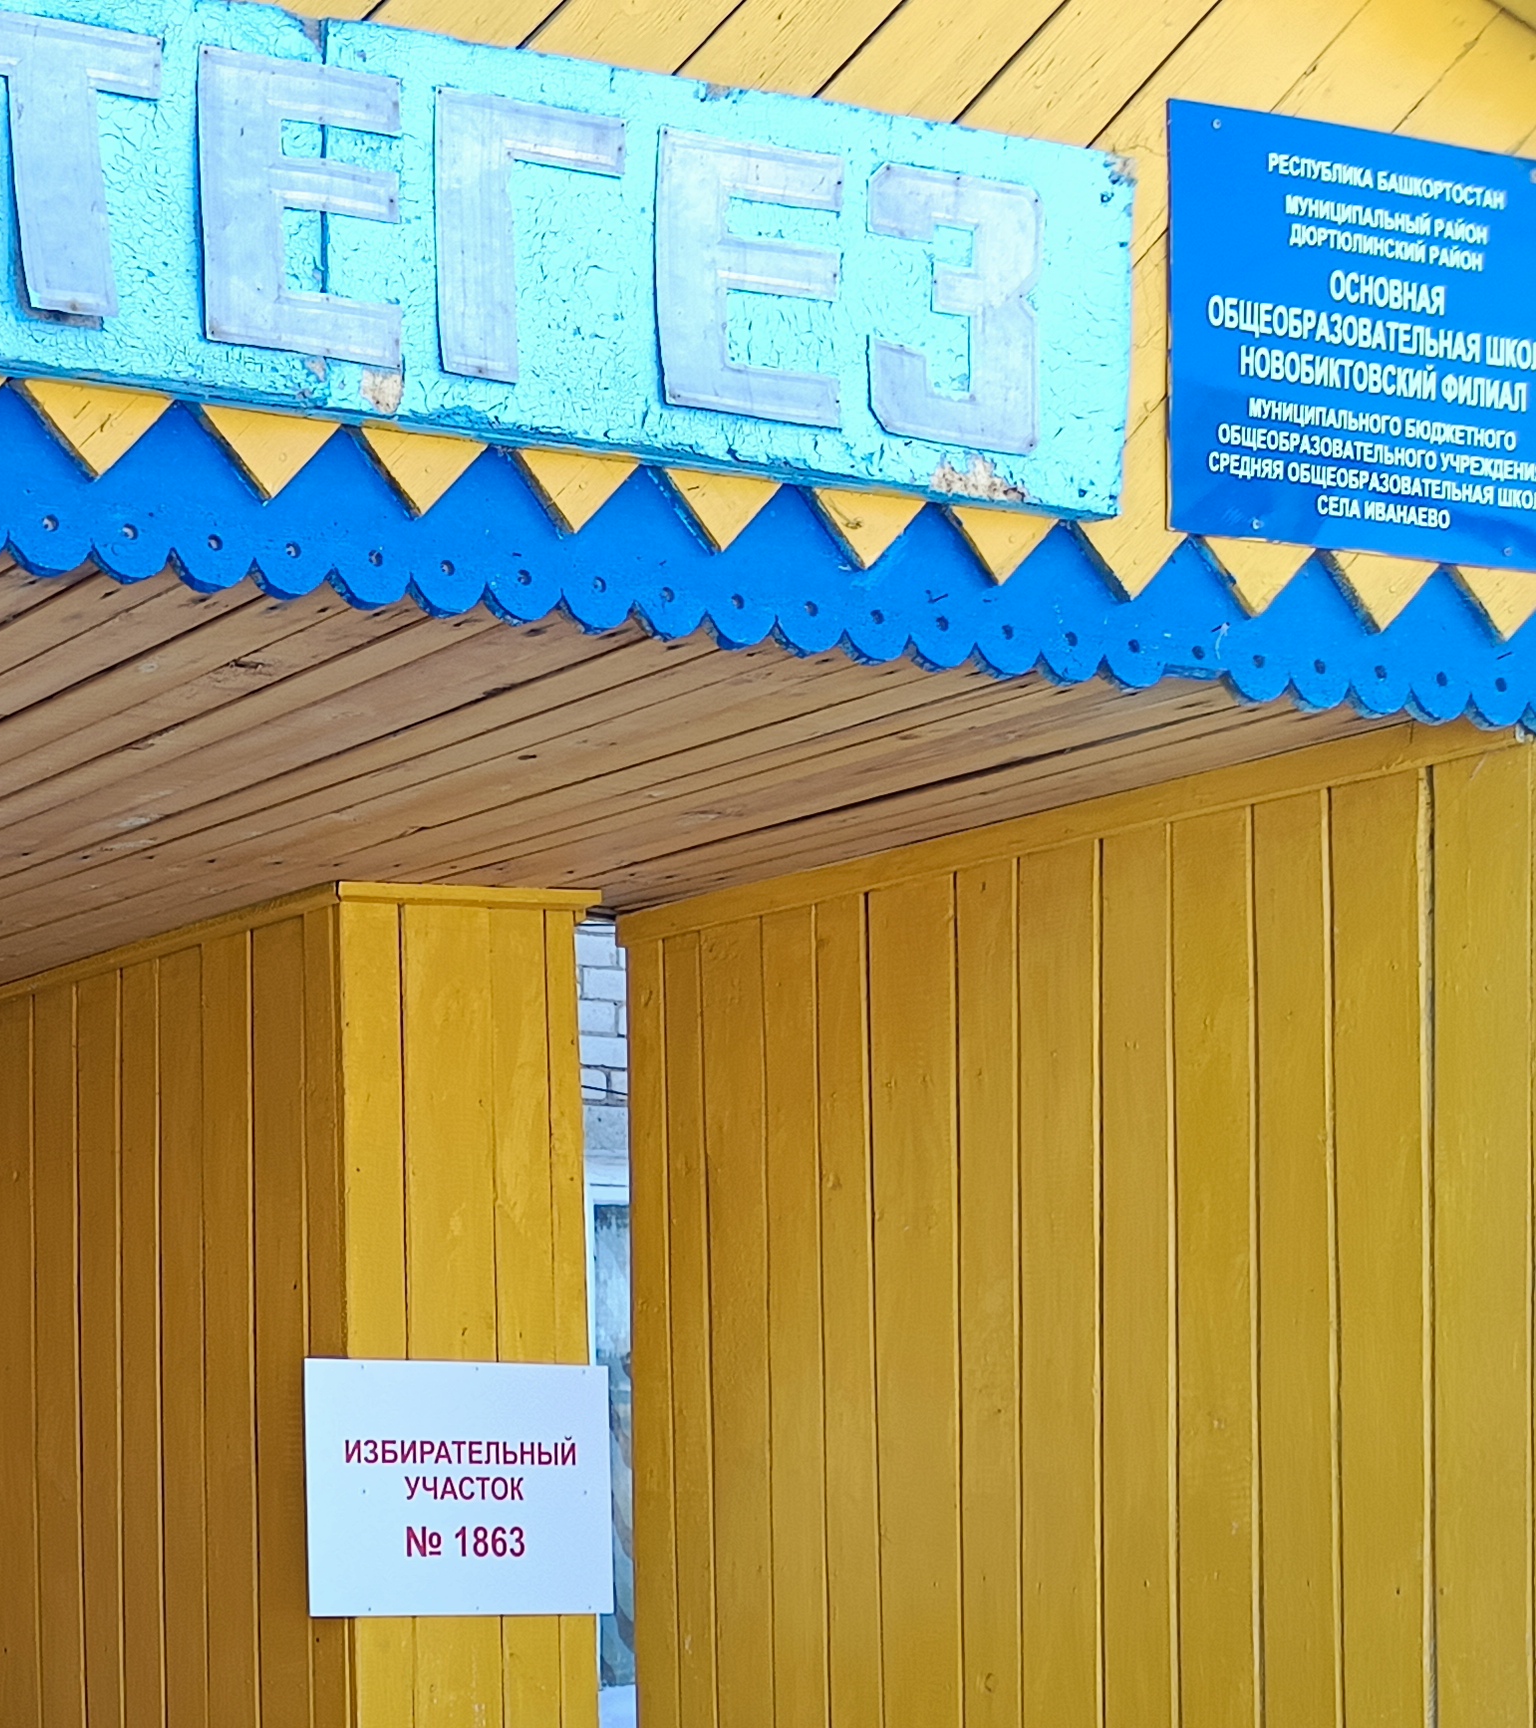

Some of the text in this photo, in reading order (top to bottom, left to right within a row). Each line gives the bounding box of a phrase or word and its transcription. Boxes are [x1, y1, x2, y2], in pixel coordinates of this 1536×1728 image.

[1268, 153, 1505, 210] РЕСПУБЛИКА БАШКОРТОСТАН
[1286, 194, 1488, 244] МУНИЦИПАЛЬНЫЙ РАЙОН
[1289, 224, 1483, 271] ДЮРТЮЛИНСКИЙ РАЙОН
[1330, 270, 1445, 316] ОСНОВНАЯ
[1208, 296, 1481, 363] ОБЩЕОБРАЗОВАТЕЛЬНАЯ
[1240, 346, 1527, 412] НОВОБИКТОВСКИЙ ФИЛИАЛ
[1218, 425, 1437, 471] ОБЩЕОБРАЗОВАТЕЛЬНОГО
[1249, 398, 1516, 451] МУНИЦИПАЛЬНОГО БЮДЖЕТНОГО
[1209, 452, 1536, 511] СРЕДНЯЯ ОБЩЕОБРАЗОВАТЕЛЬНАЯ ШКО
[1318, 495, 1450, 528] СЕЛА ИВАНАЕВО
[345, 1436, 576, 1465] ИЗБИРАТЕЛЬНЫЙ
[405, 1477, 524, 1500] УЧАСТОК
[406, 1526, 525, 1557] № 1863
